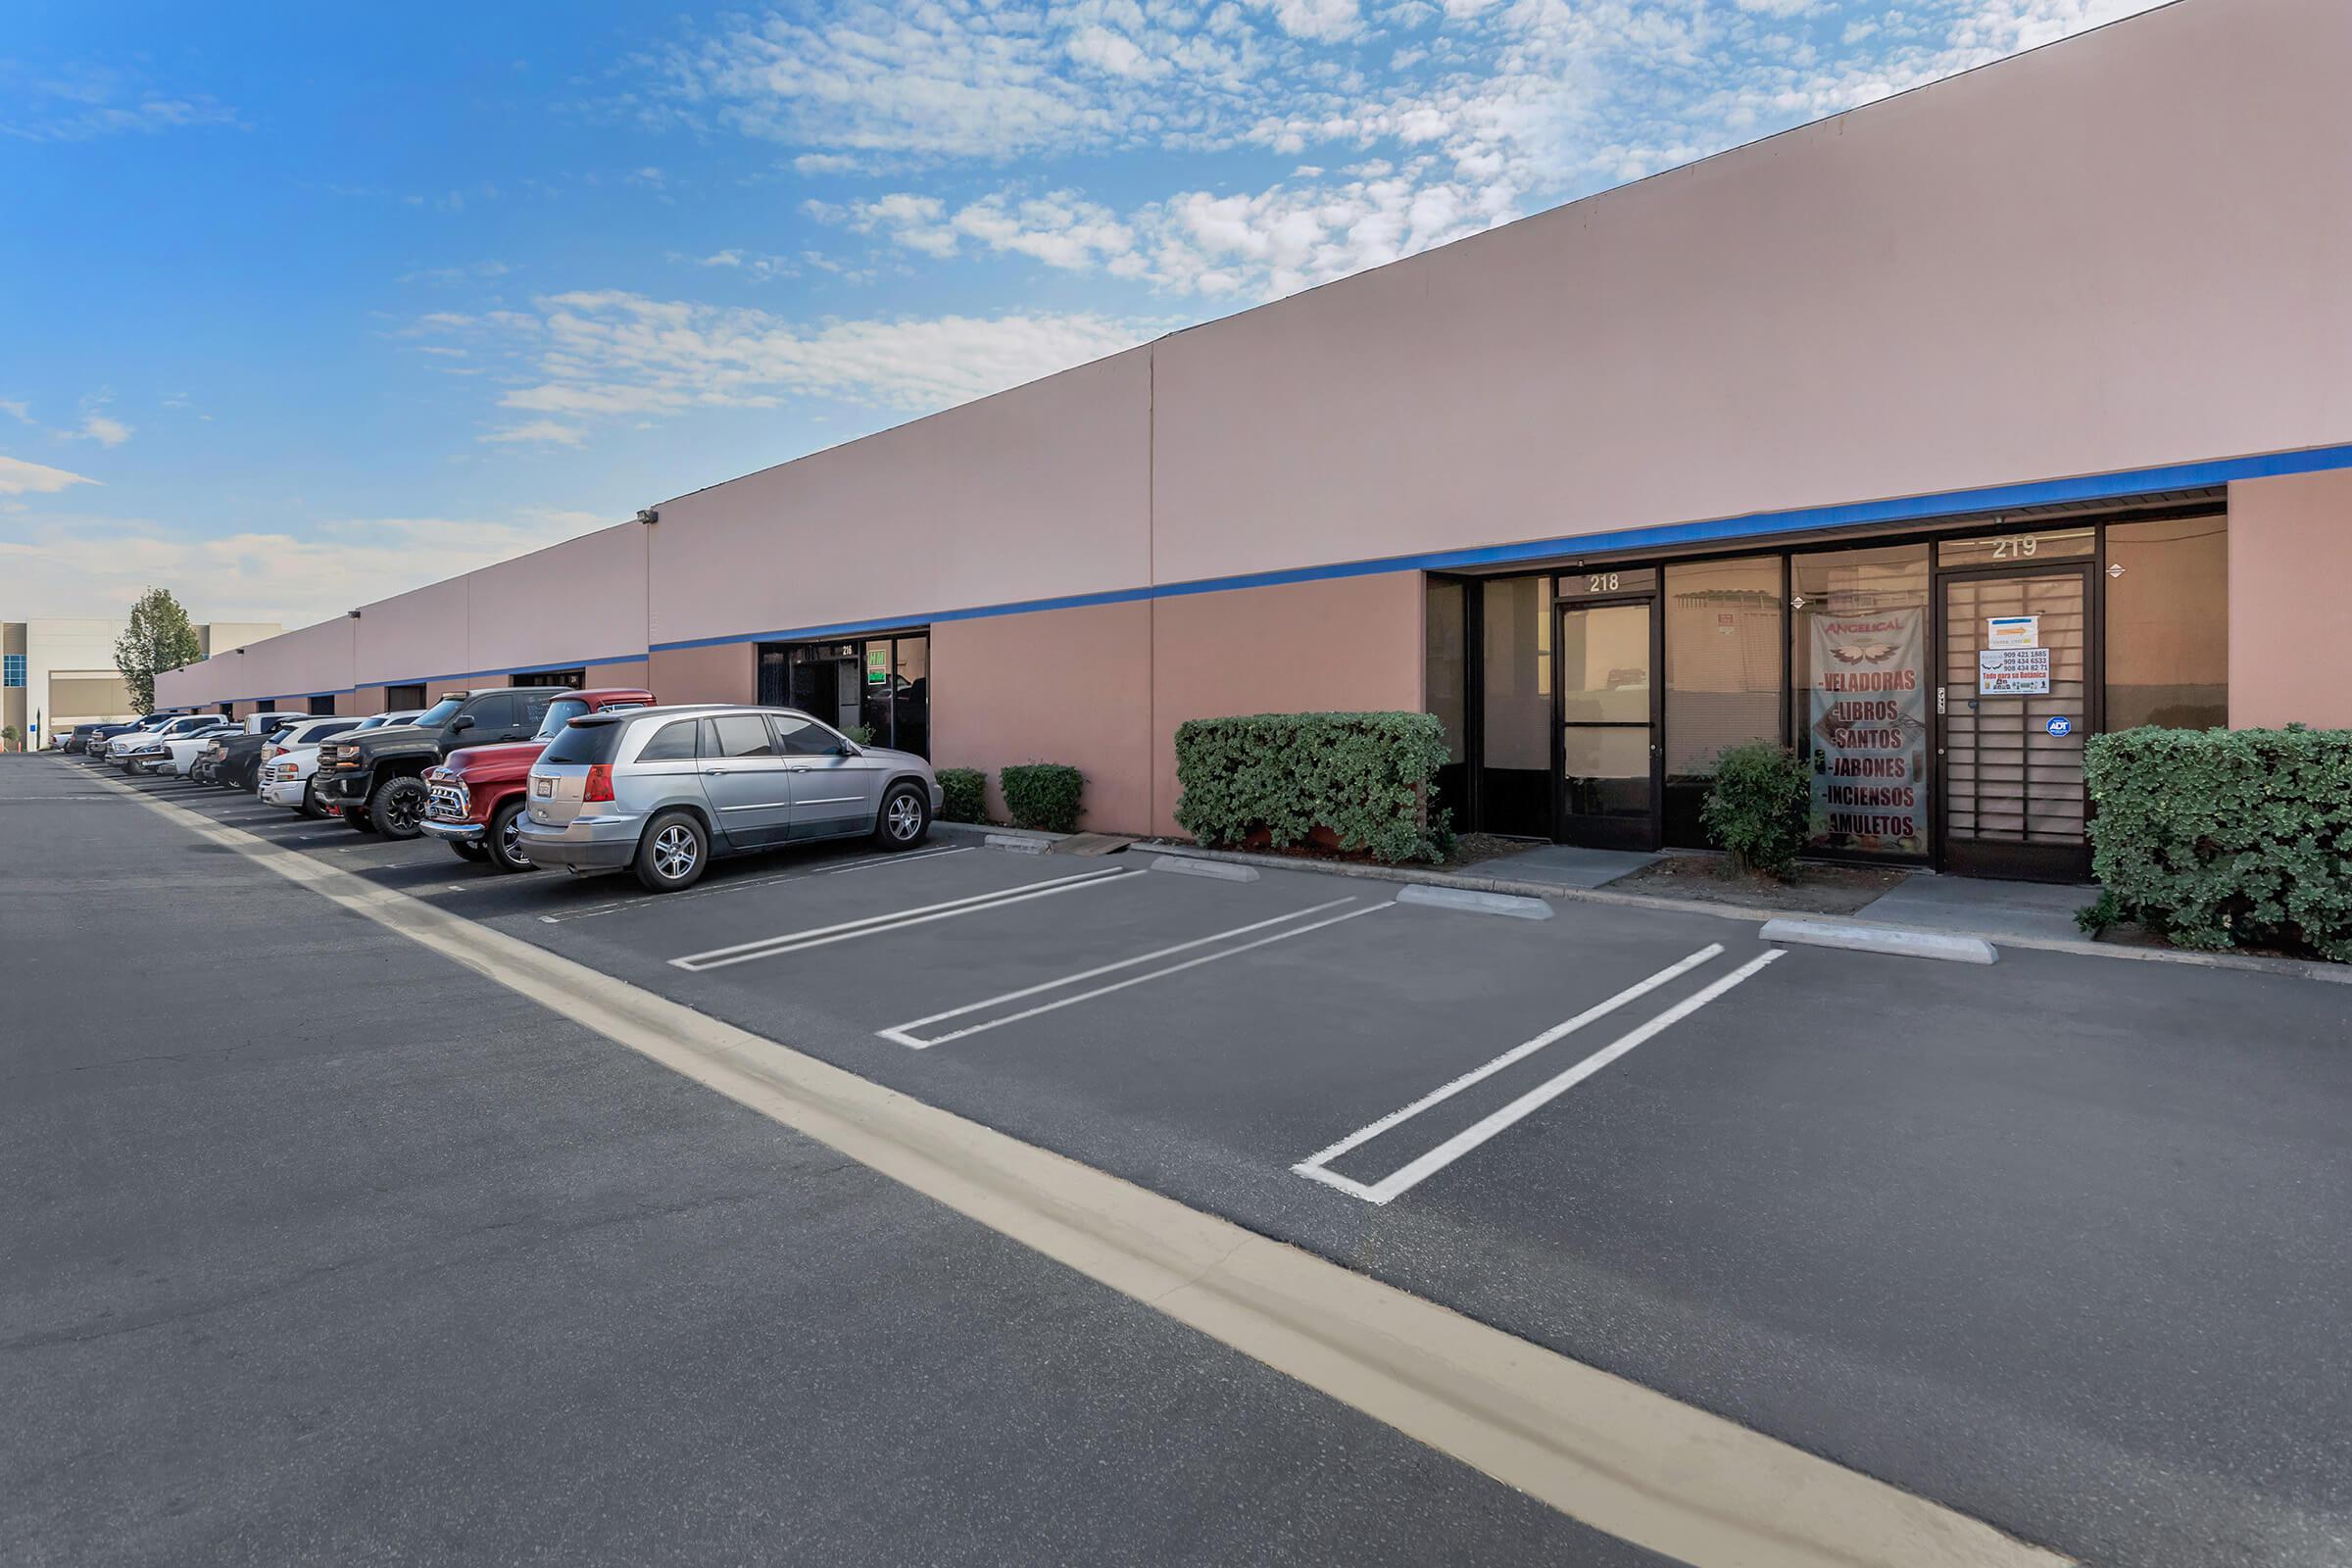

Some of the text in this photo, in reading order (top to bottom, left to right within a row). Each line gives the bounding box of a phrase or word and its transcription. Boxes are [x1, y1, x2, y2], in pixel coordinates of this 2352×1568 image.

[1992, 535, 2036, 558] 219
[1591, 573, 1619, 592] 218
[1825, 617, 1904, 635] ANGELICAL
[2049, 721, 2068, 730] ADT
